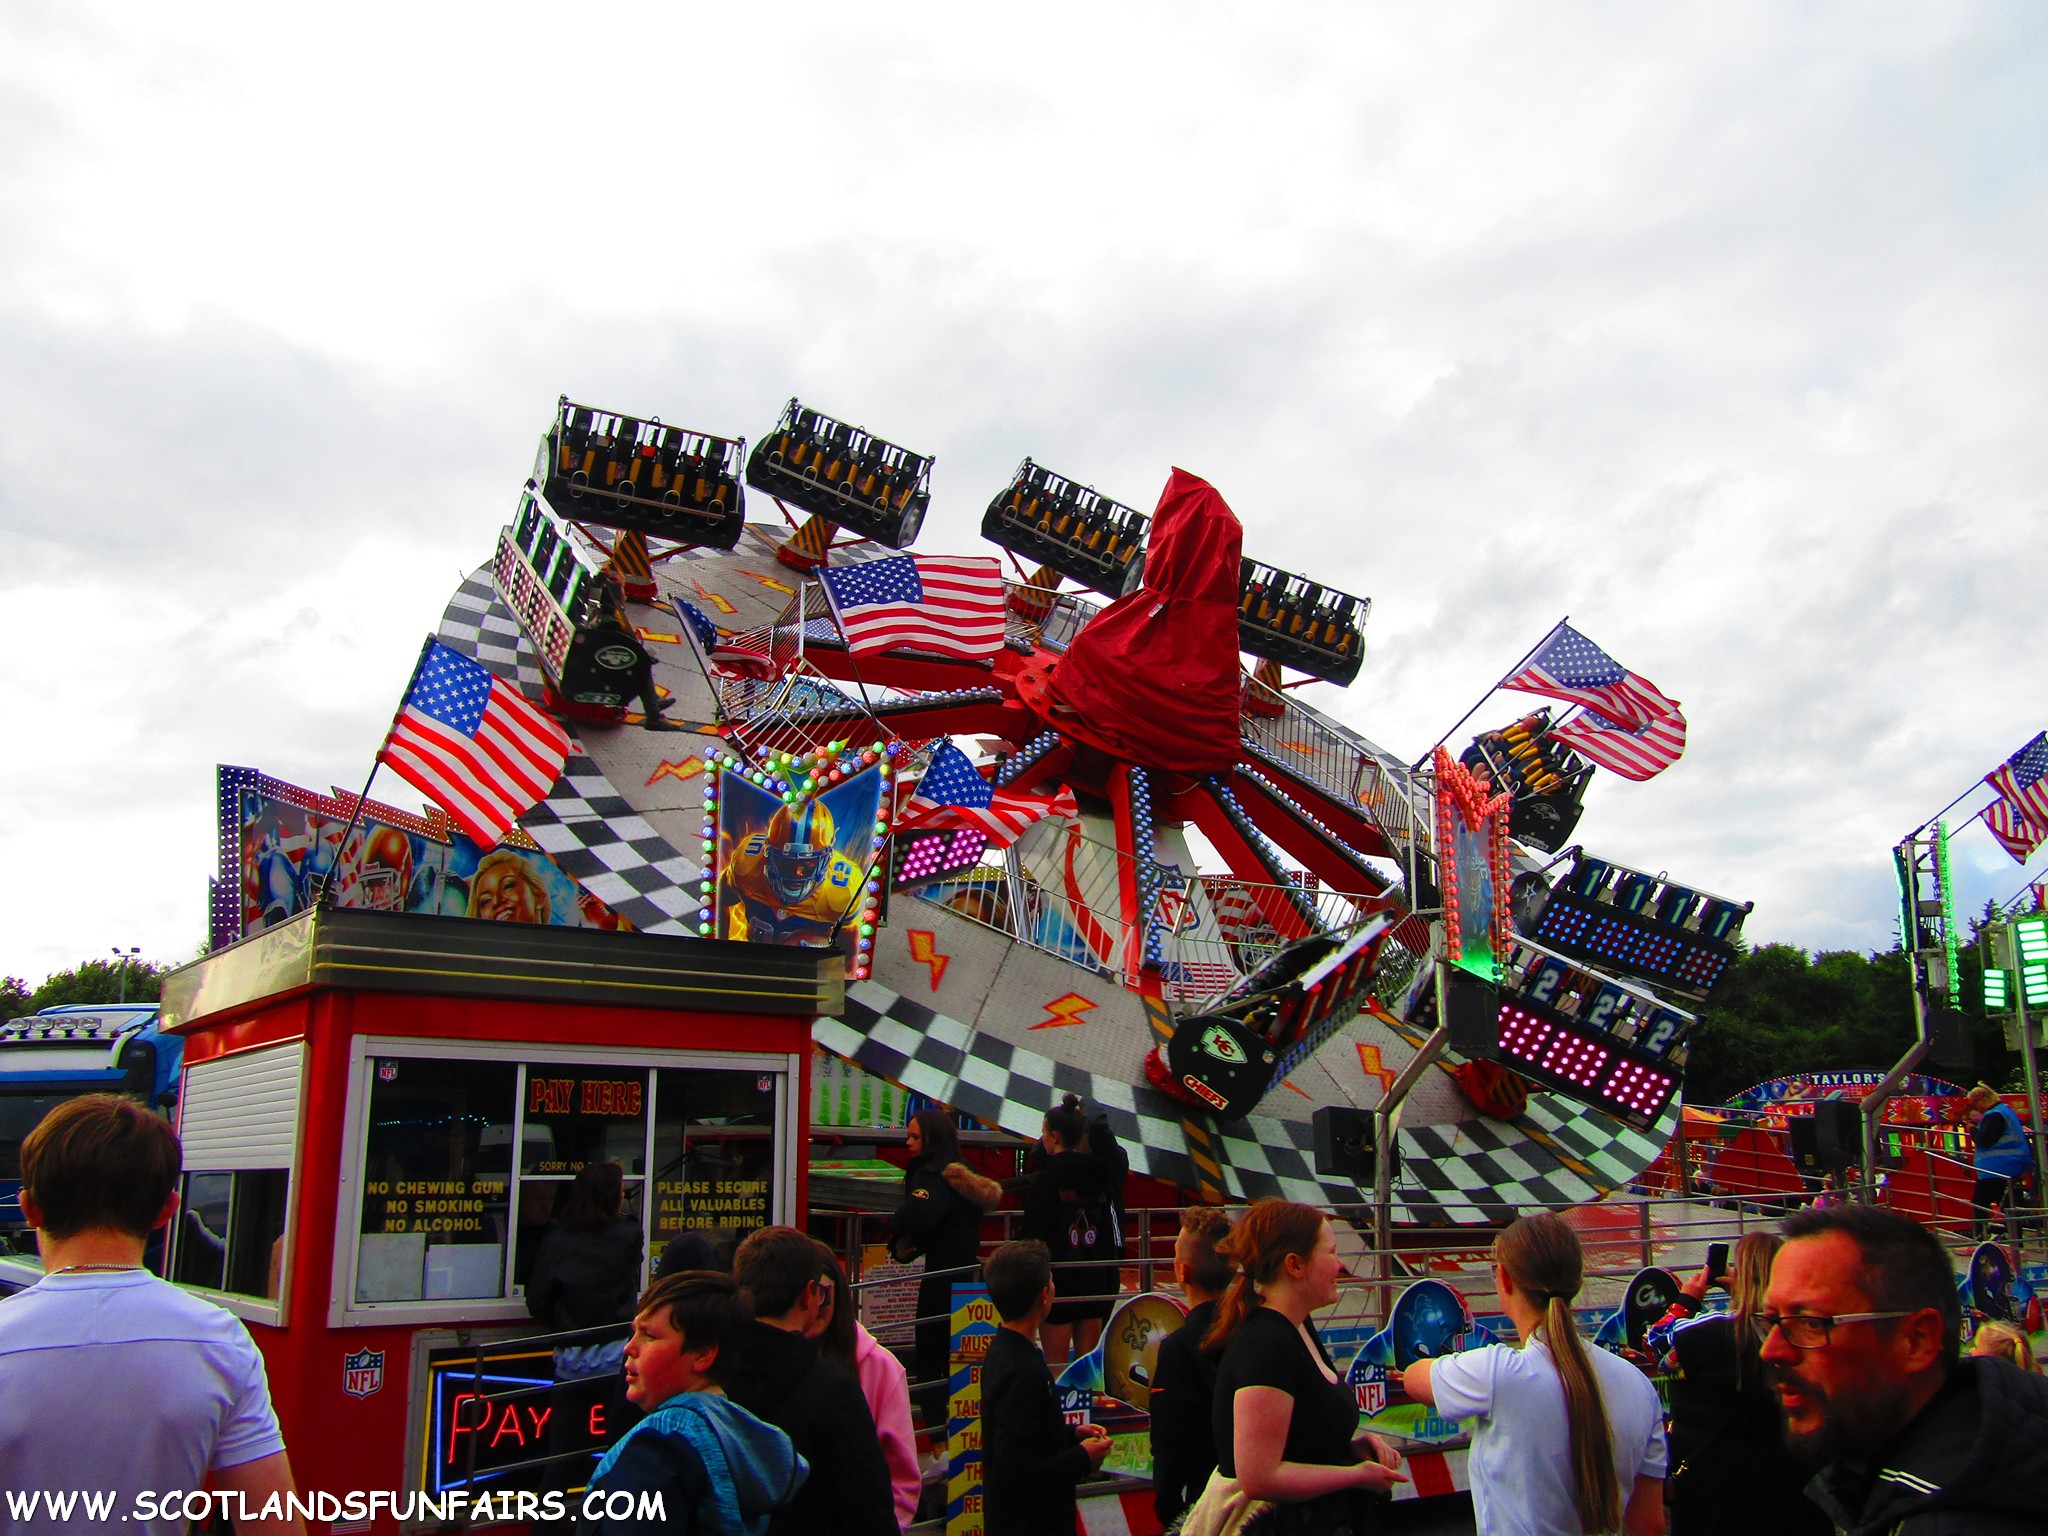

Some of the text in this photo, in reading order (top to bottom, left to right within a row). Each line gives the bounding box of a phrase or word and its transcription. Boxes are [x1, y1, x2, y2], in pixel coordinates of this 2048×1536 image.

[1584, 868, 1731, 937] 1 1 1 1
[1535, 968, 1675, 1053] 2 2 2
[381, 1068, 395, 1078] NFL
[1811, 1073, 1886, 1085] TAYLOR'S
[529, 1078, 642, 1116] PAY HERE
[1184, 1075, 1229, 1110] CHIEFS
[539, 1160, 567, 1172] SORRY
[570, 1161, 585, 1172] NO
[367, 1181, 504, 1195] NO CHEWING GUM
[657, 1180, 768, 1194] PLEASE SECURE
[386, 1200, 484, 1214] NO SMOKING
[660, 1198, 766, 1212] ALL VALUABLES
[384, 1218, 483, 1232] NO ALCOHOL
[659, 1215, 765, 1230] BEFORE RIDING
[967, 1305, 993, 1321] YOU
[346, 1370, 382, 1395] NFL
[971, 1367, 982, 1384] B
[1356, 1384, 1385, 1410] NFL
[447, 1392, 552, 1465] PAY
[960, 1432, 982, 1450] THA
[965, 1463, 982, 1480] TH
[962, 1496, 983, 1513] RE
